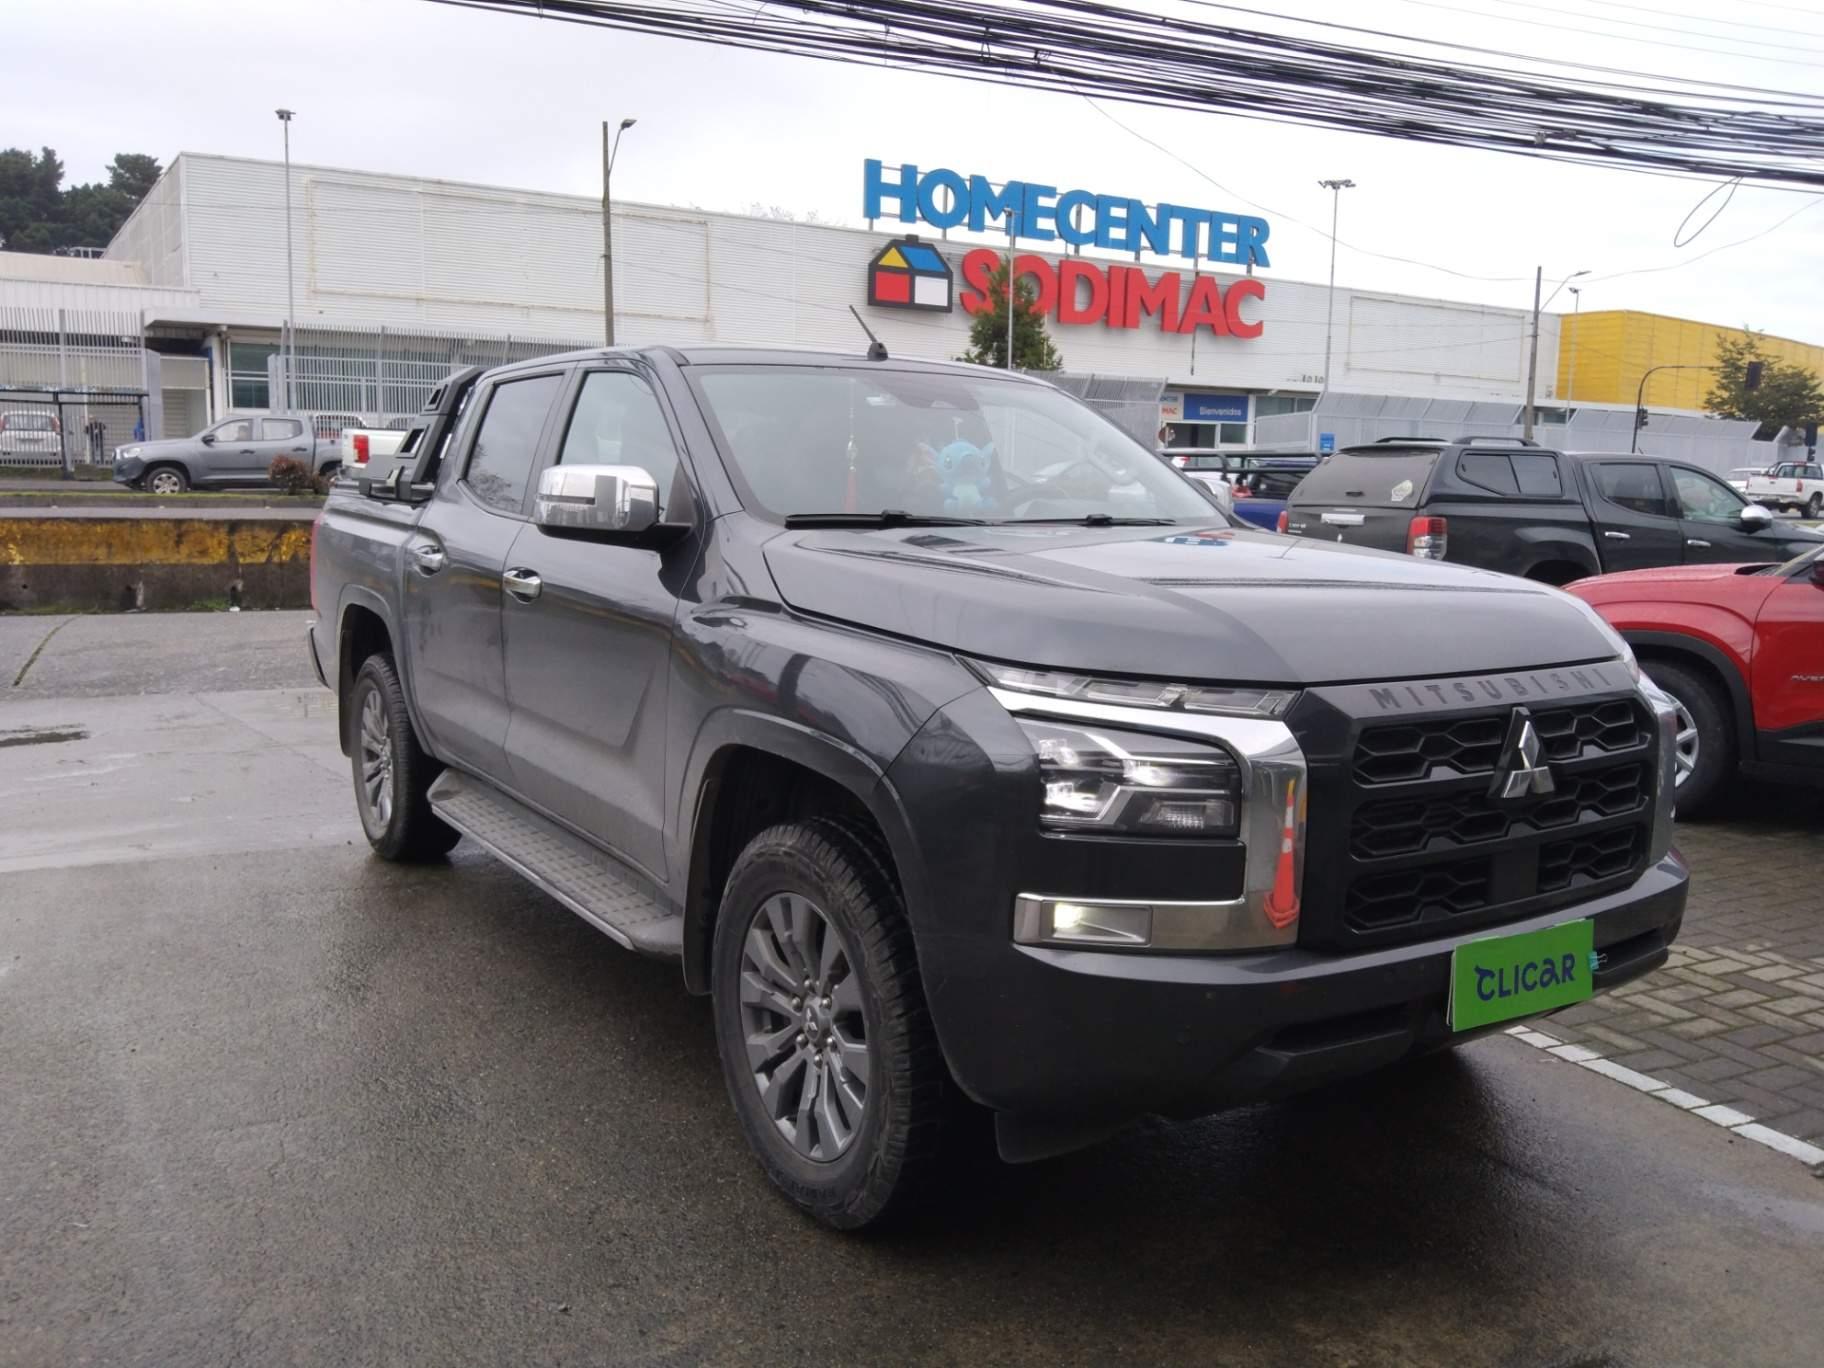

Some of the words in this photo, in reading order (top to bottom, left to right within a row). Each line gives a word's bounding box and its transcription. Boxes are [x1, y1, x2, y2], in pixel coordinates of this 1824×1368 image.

[863, 158, 1271, 268] HOMECENTER
[960, 248, 1265, 339] SODIMAC
[1199, 406, 1242, 416] Bienvenidos
[1369, 667, 1612, 709] MITSUBISHI
